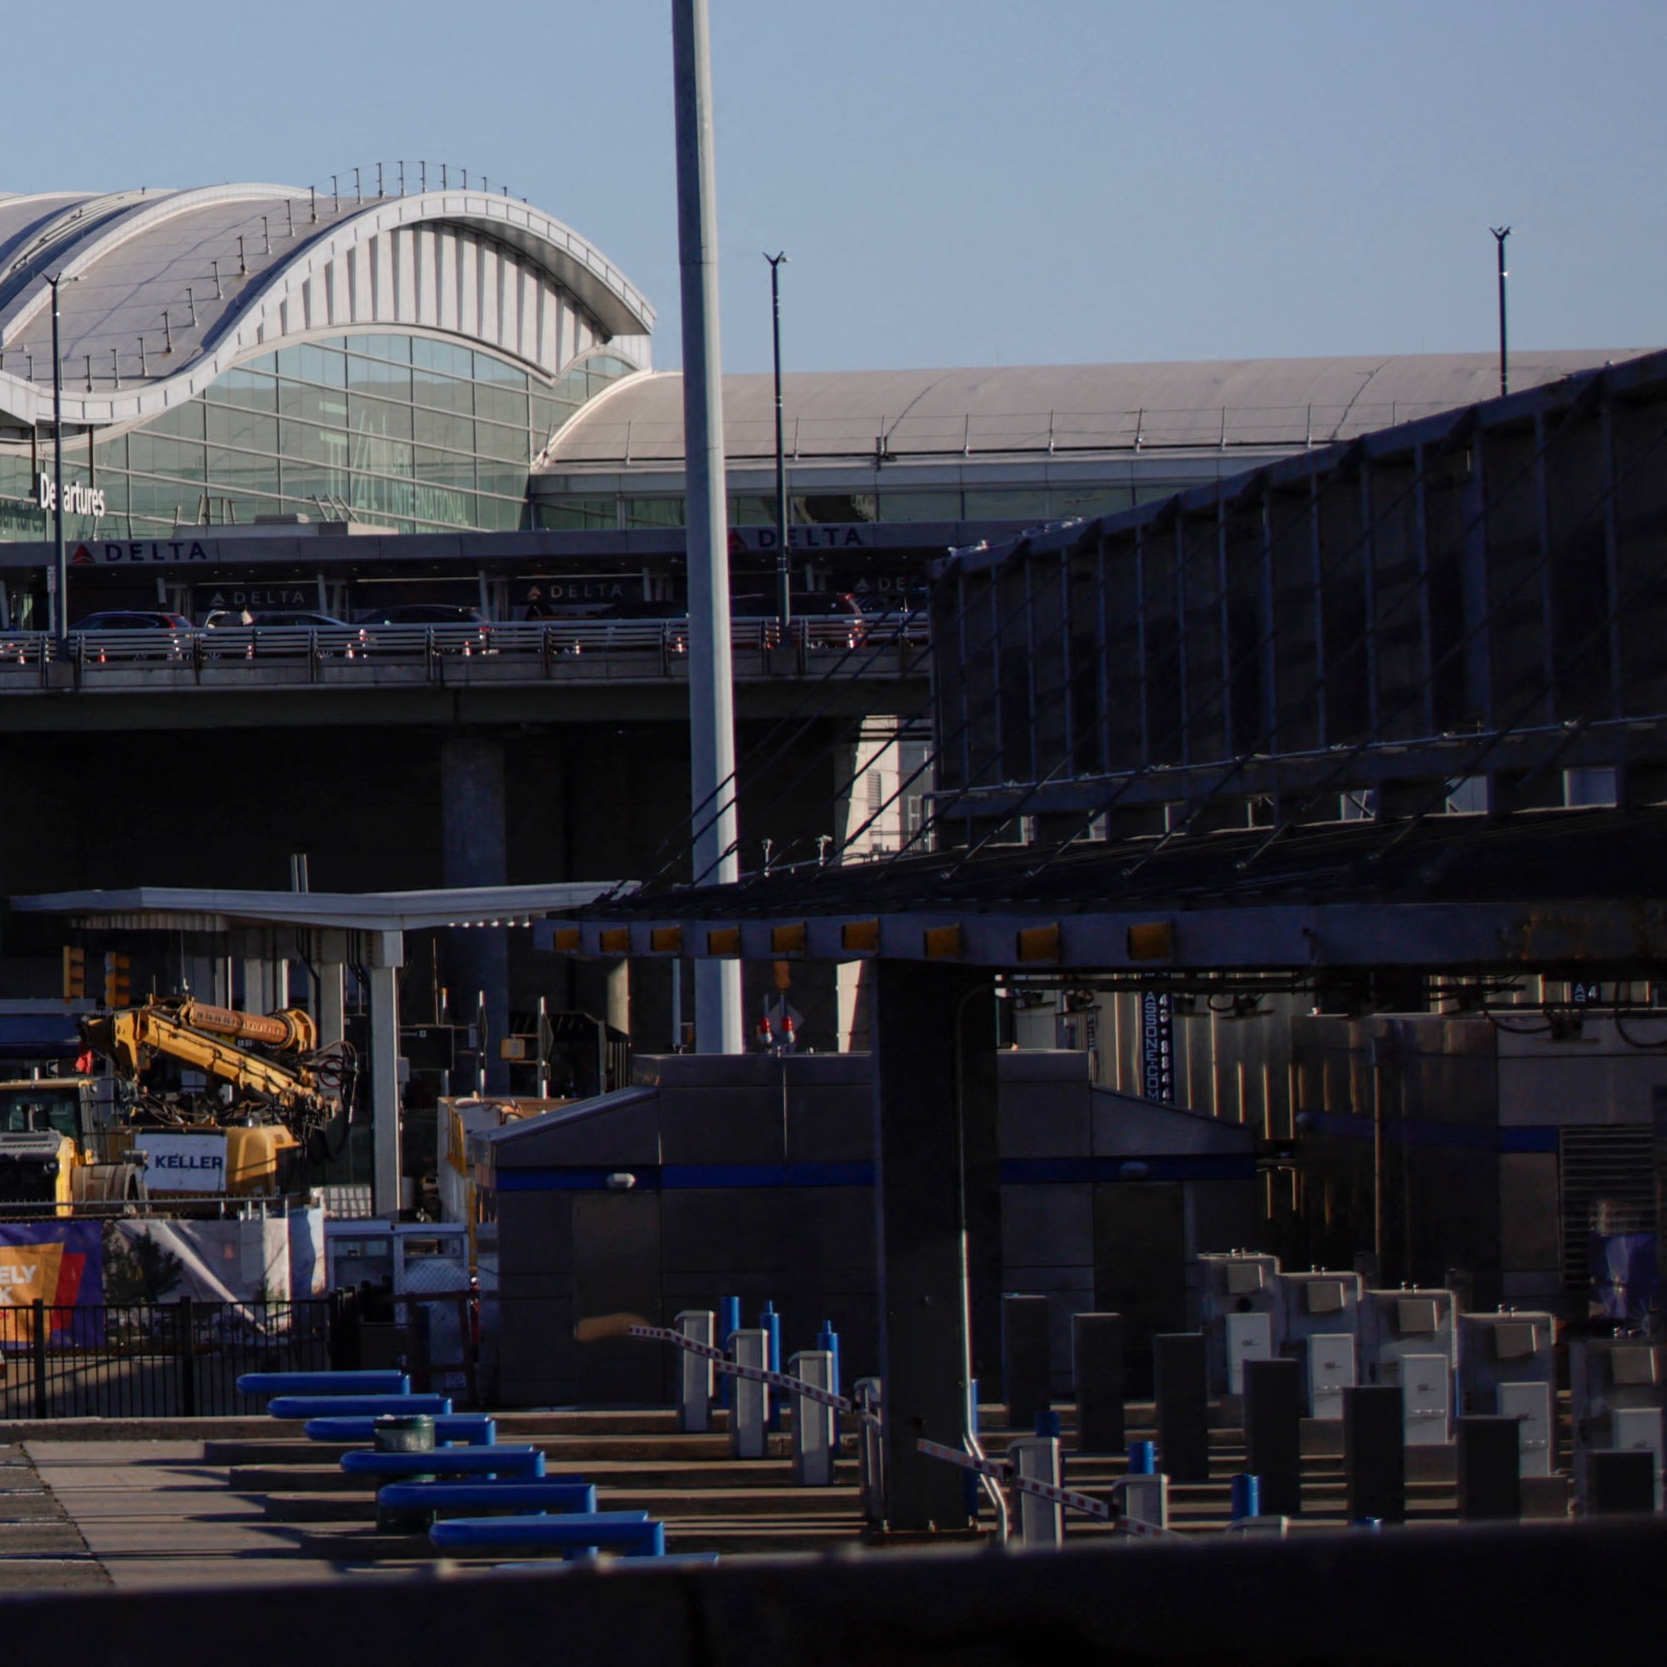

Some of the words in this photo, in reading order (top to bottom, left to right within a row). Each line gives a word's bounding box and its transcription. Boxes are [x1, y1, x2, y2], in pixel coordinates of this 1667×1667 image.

[40, 471, 105, 517] Deartures
[758, 527, 863, 548] DELTA
[105, 542, 207, 561] DELTA
[233, 591, 305, 605] DELTA
[550, 584, 624, 599] DELTA
[155, 1155, 223, 1169] KELLER
